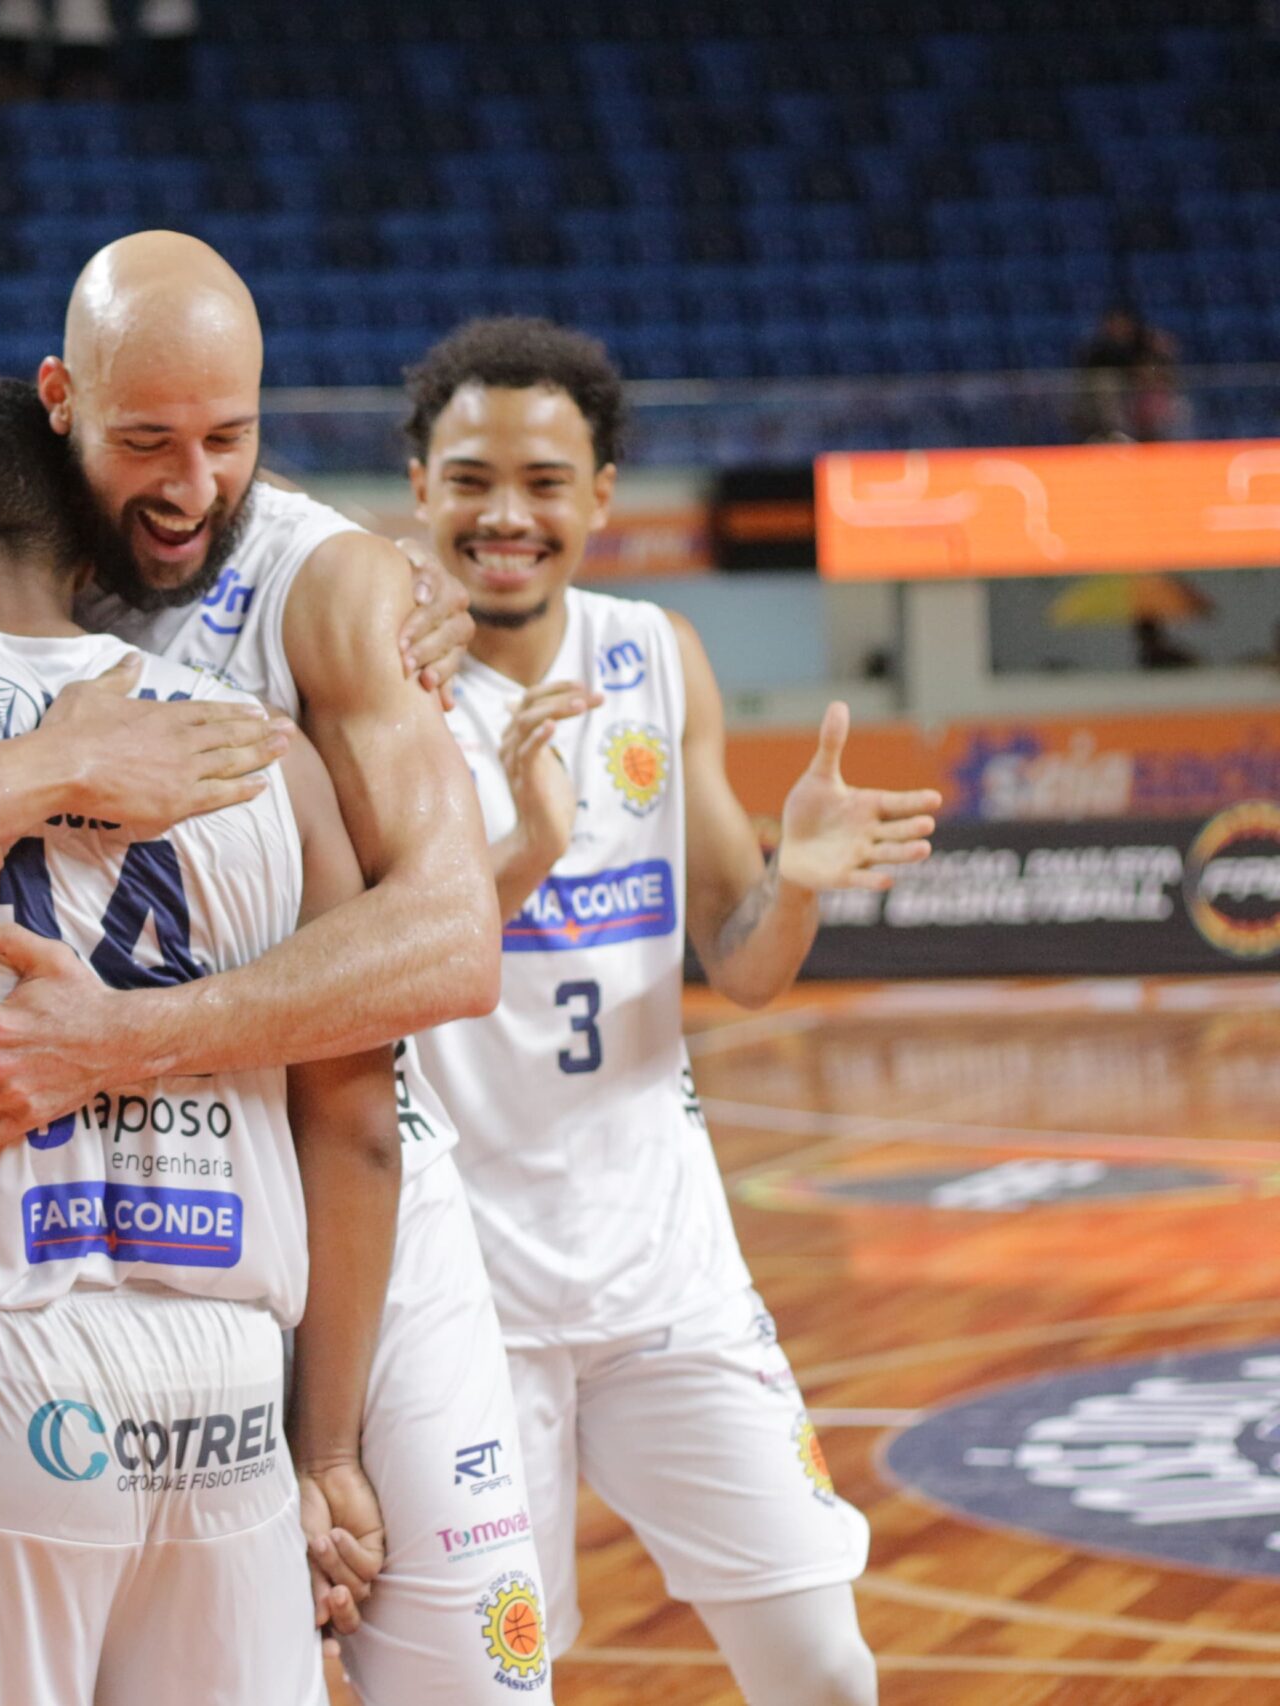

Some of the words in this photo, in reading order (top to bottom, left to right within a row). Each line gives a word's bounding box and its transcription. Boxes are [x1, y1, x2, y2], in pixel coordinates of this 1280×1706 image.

[554, 978, 603, 1074] 3
[112, 1151, 233, 1178] engenharia
[114, 1201, 234, 1238] CONDE
[114, 1402, 276, 1472] COTREL
